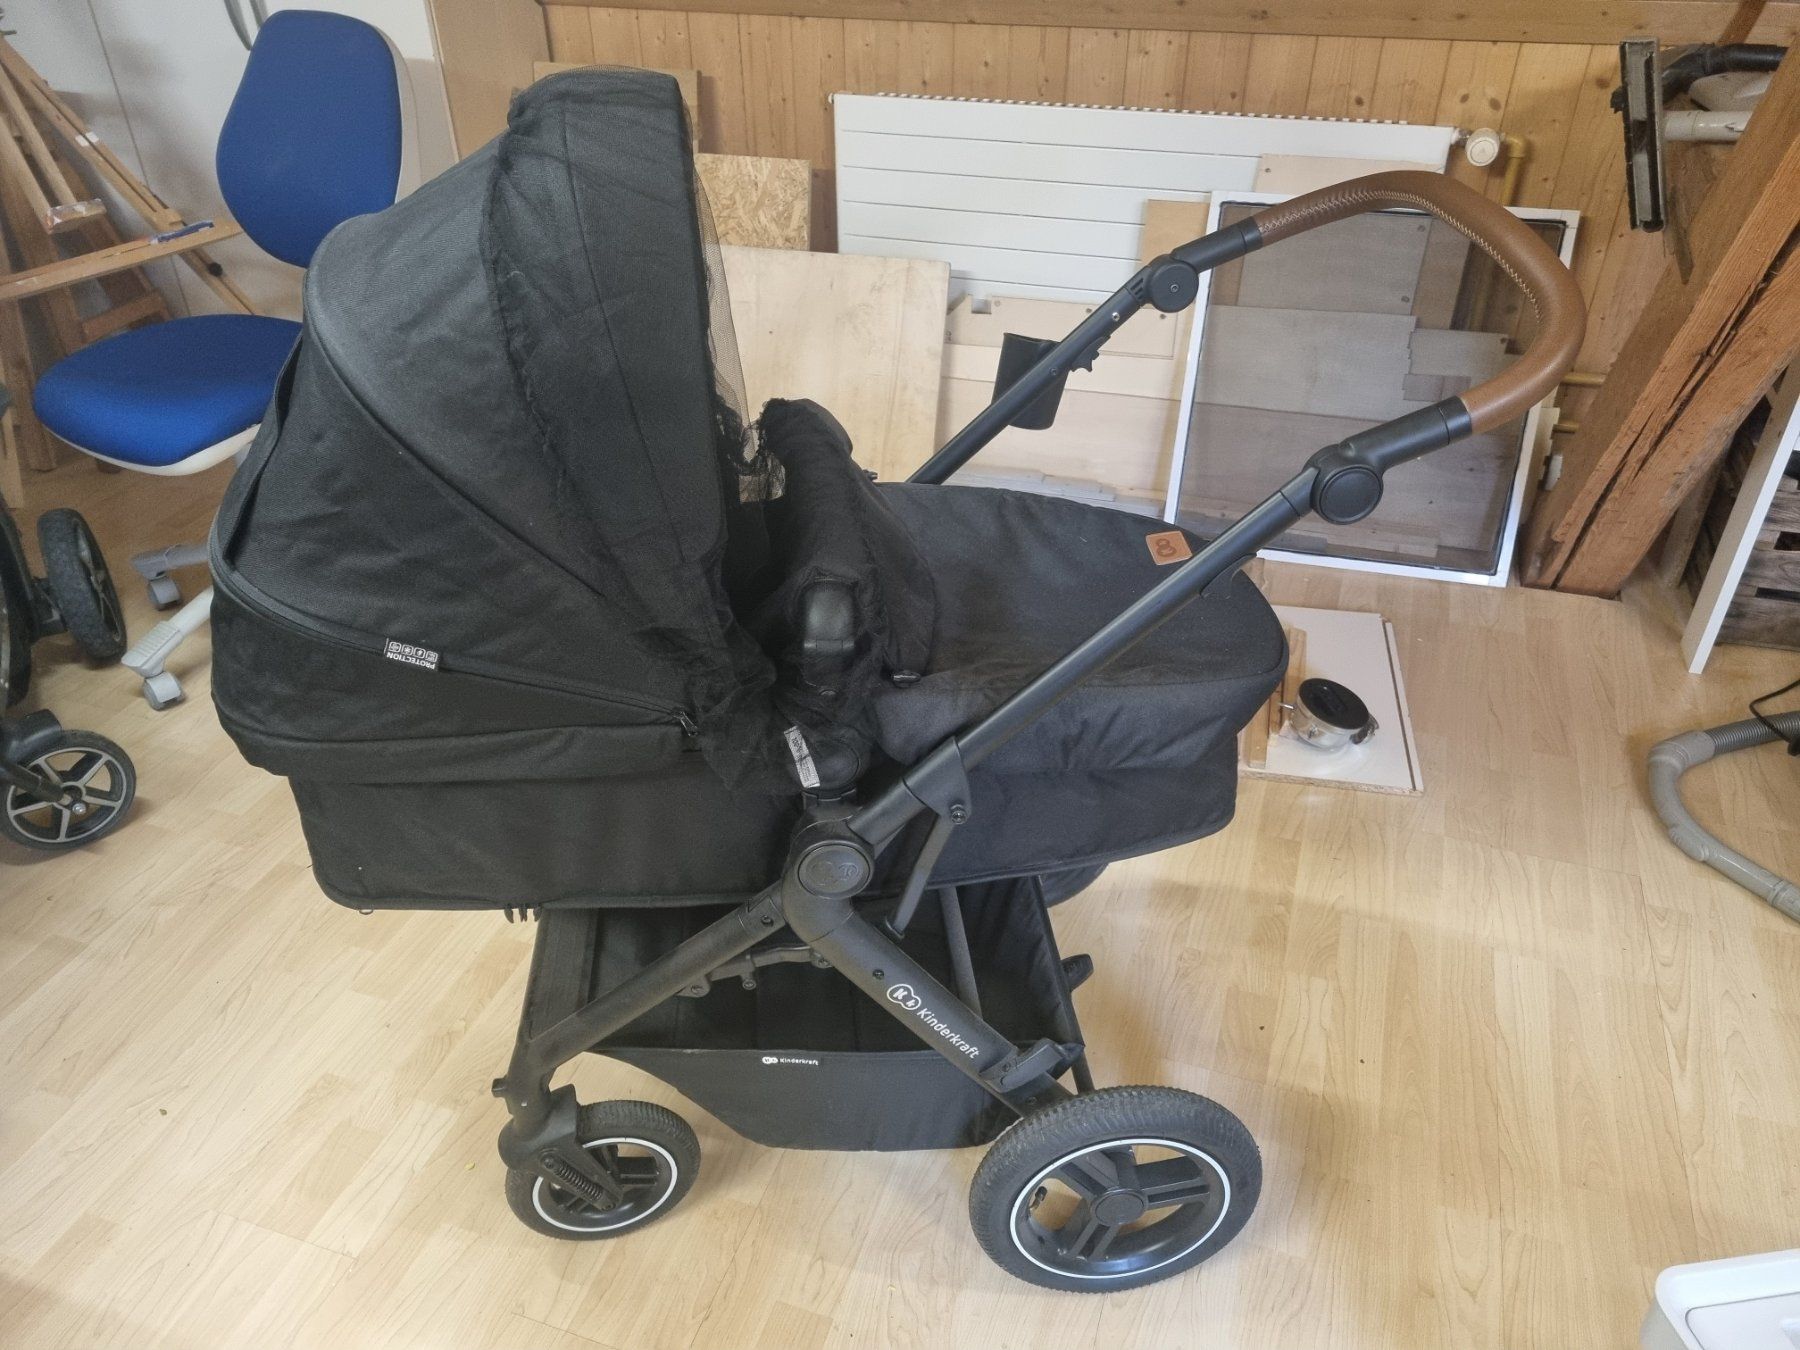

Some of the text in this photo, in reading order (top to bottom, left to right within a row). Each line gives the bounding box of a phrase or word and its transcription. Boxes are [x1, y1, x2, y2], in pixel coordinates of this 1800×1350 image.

[386, 652, 436, 669] PROTECTION
[916, 1008, 980, 1059] Kinderkraft
[779, 1057, 819, 1066] Kinderkraft
